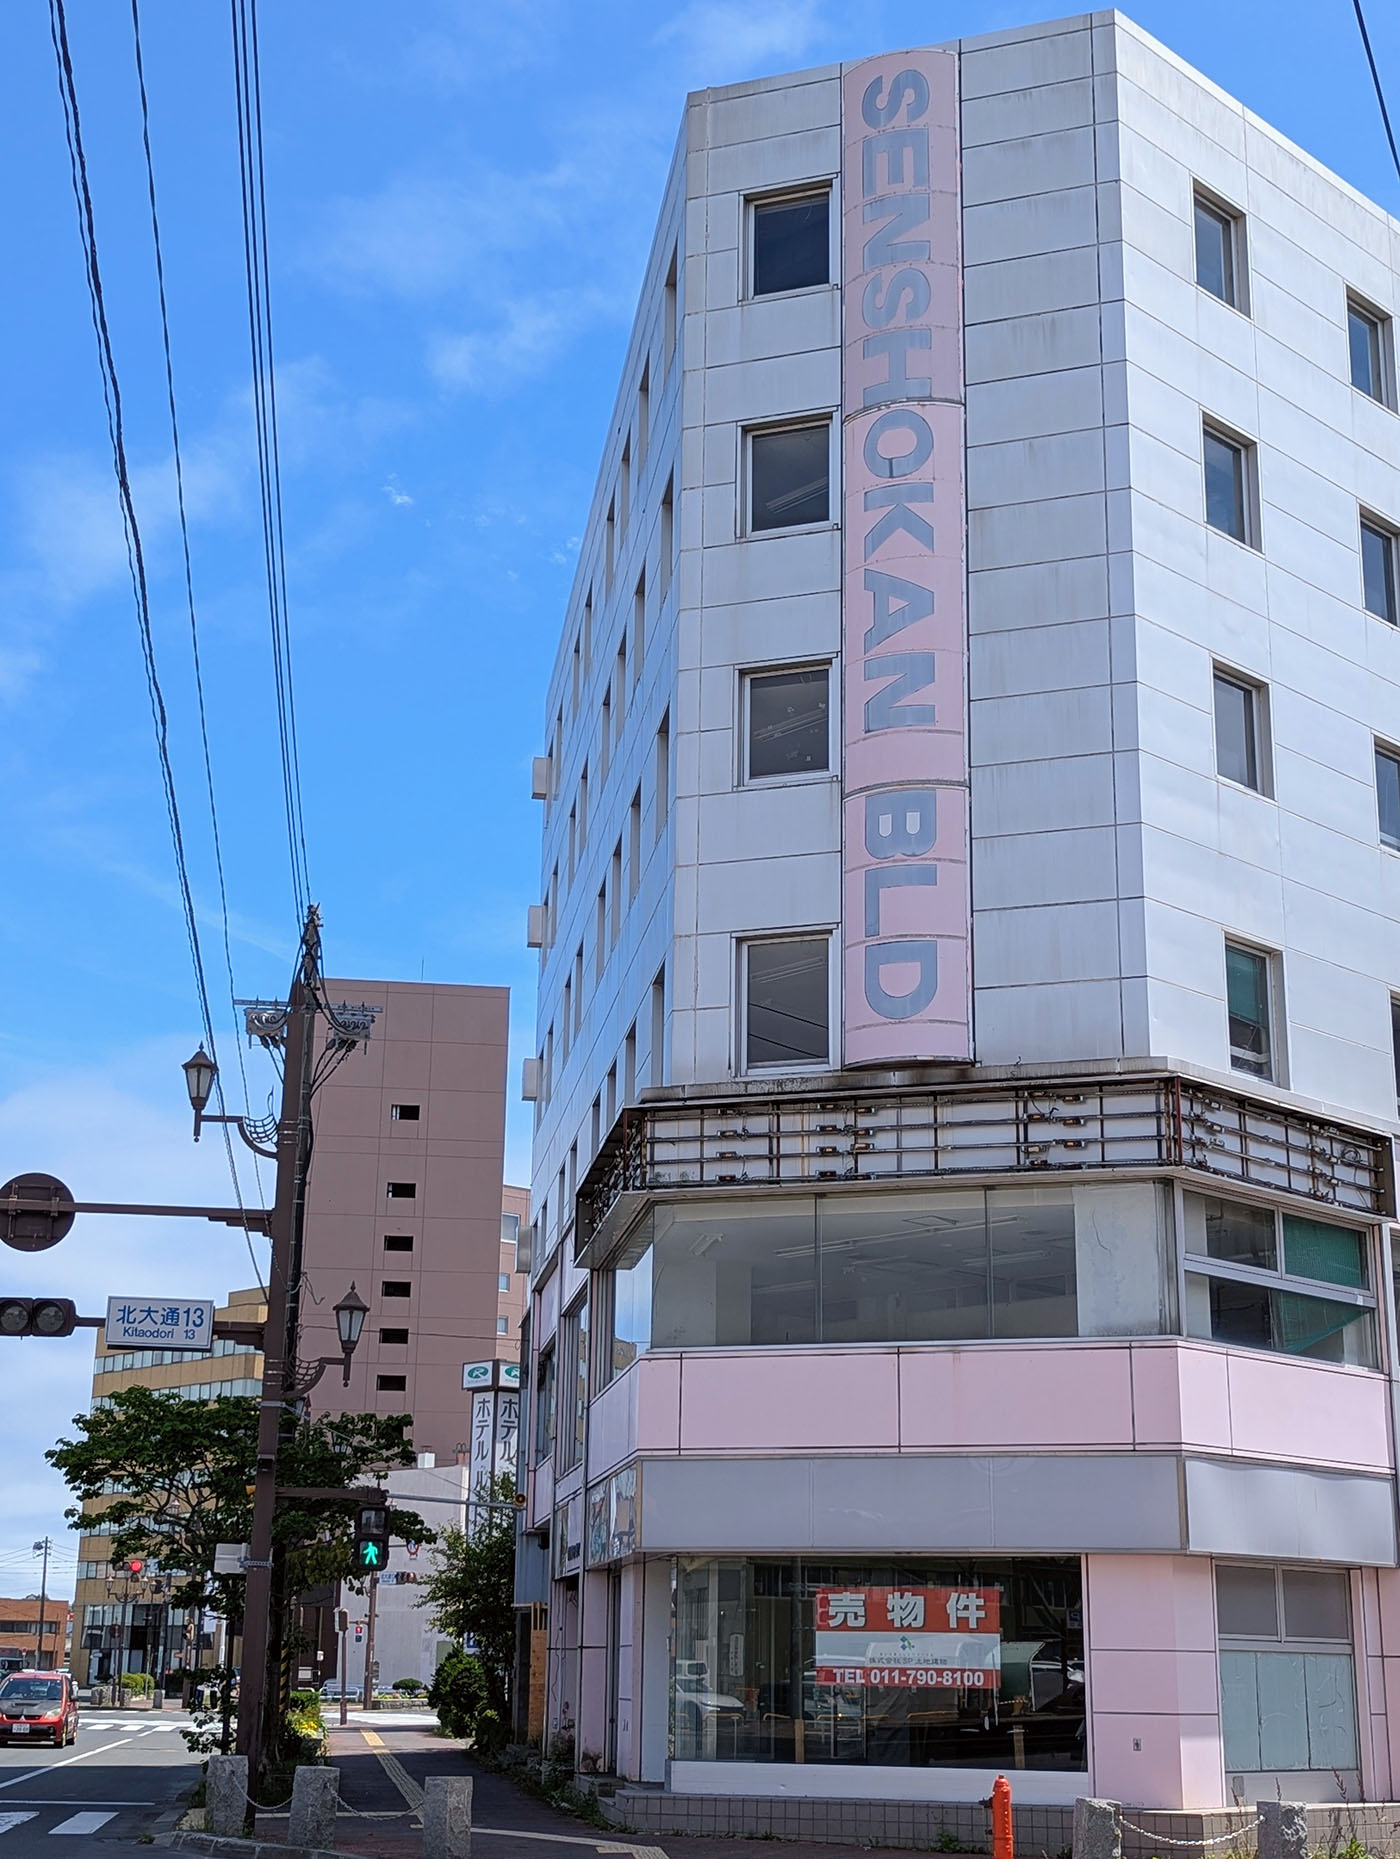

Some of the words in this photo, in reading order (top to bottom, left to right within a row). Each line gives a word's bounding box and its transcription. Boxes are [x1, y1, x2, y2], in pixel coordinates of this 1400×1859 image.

[862, 69, 936, 734] SENSHOKAN
[865, 789, 938, 1020] BLD
[116, 1304, 205, 1328] 北大通13
[122, 1326, 175, 1339] Kitaodori
[183, 1328, 196, 1340] 13
[827, 1591, 986, 1629] 売物件
[833, 1668, 866, 1684] TEL
[870, 1669, 985, 1686] 011-790-8100
